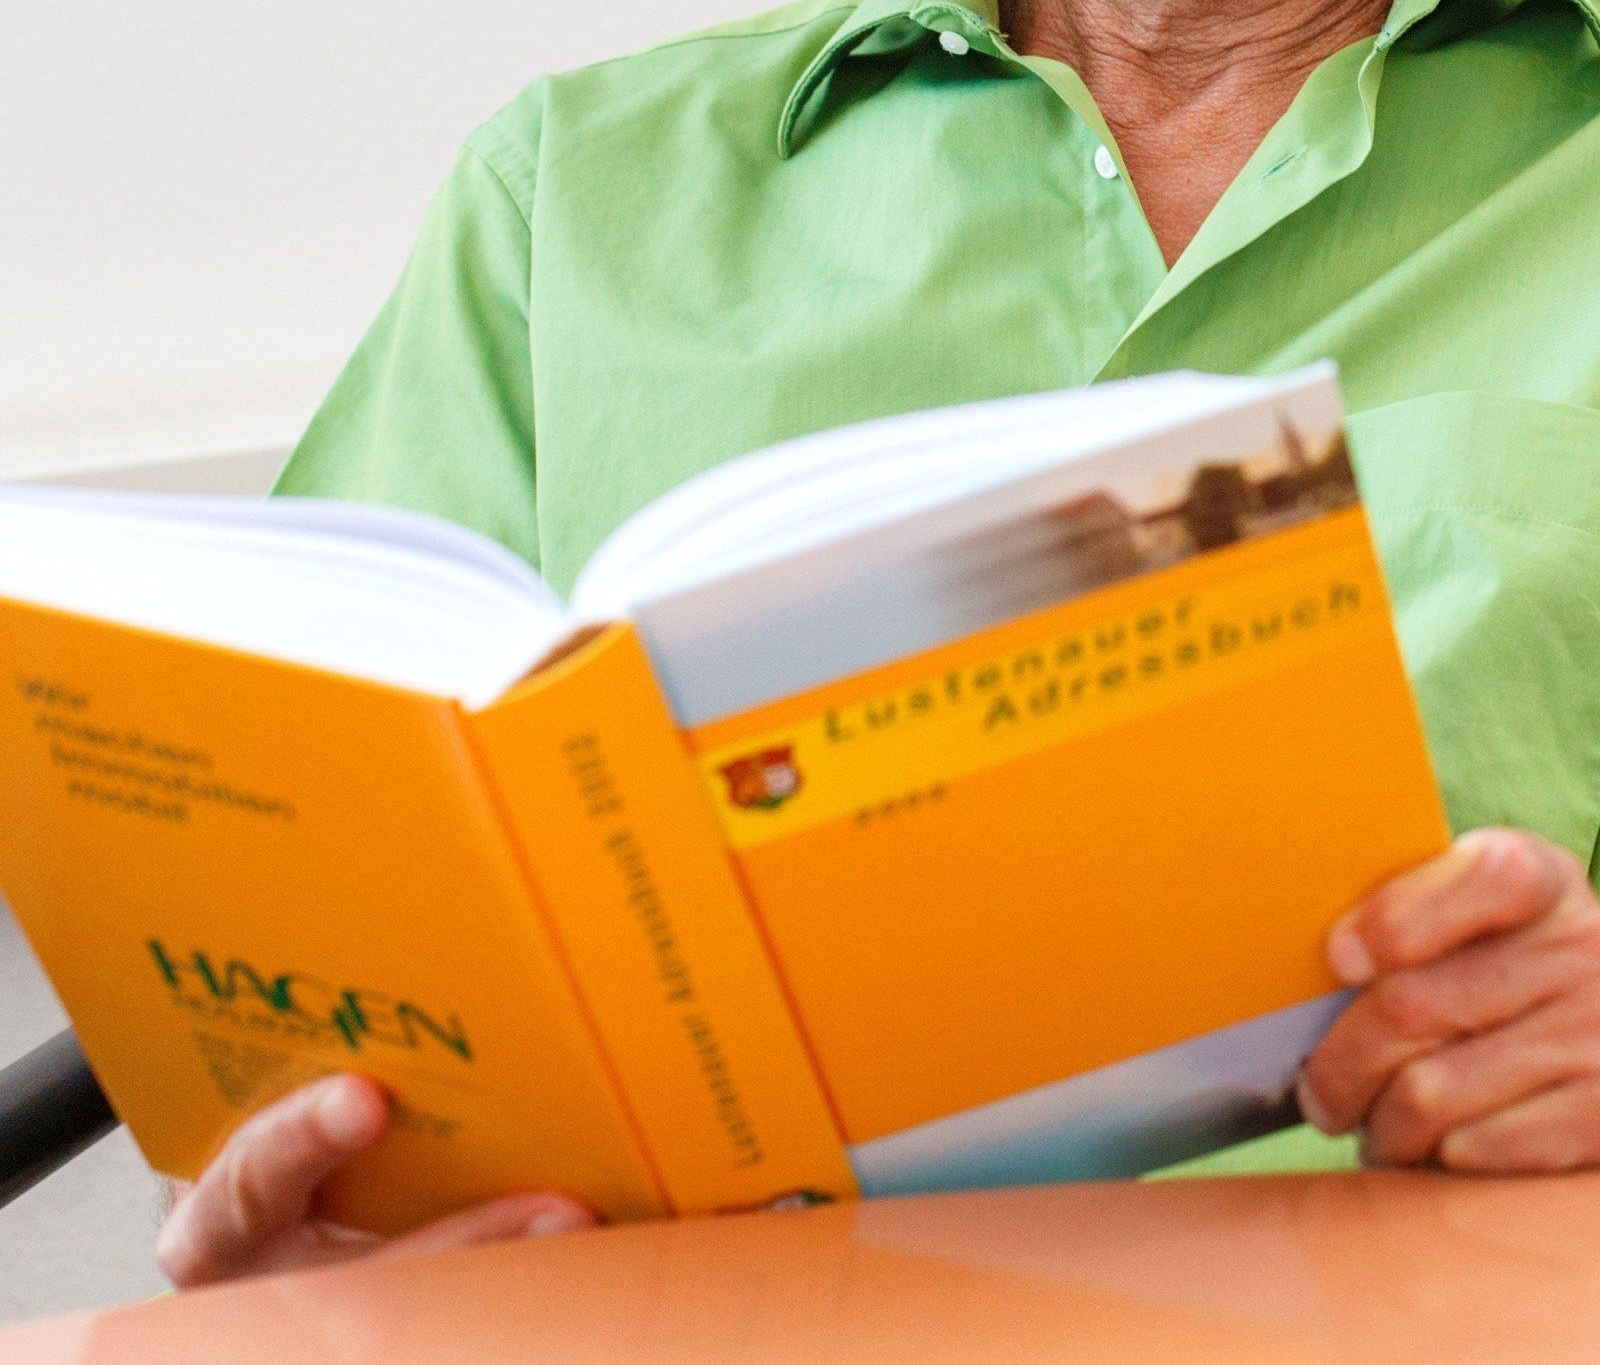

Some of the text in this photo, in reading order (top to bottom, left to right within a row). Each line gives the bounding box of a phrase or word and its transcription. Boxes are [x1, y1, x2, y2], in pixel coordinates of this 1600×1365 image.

[823, 597, 1197, 744] Lustenauer
[980, 582, 1363, 734] Adressbuch
[35, 713, 213, 771] machen
[50, 742, 296, 822] Immobilien
[147, 938, 476, 1062] HAGEN
